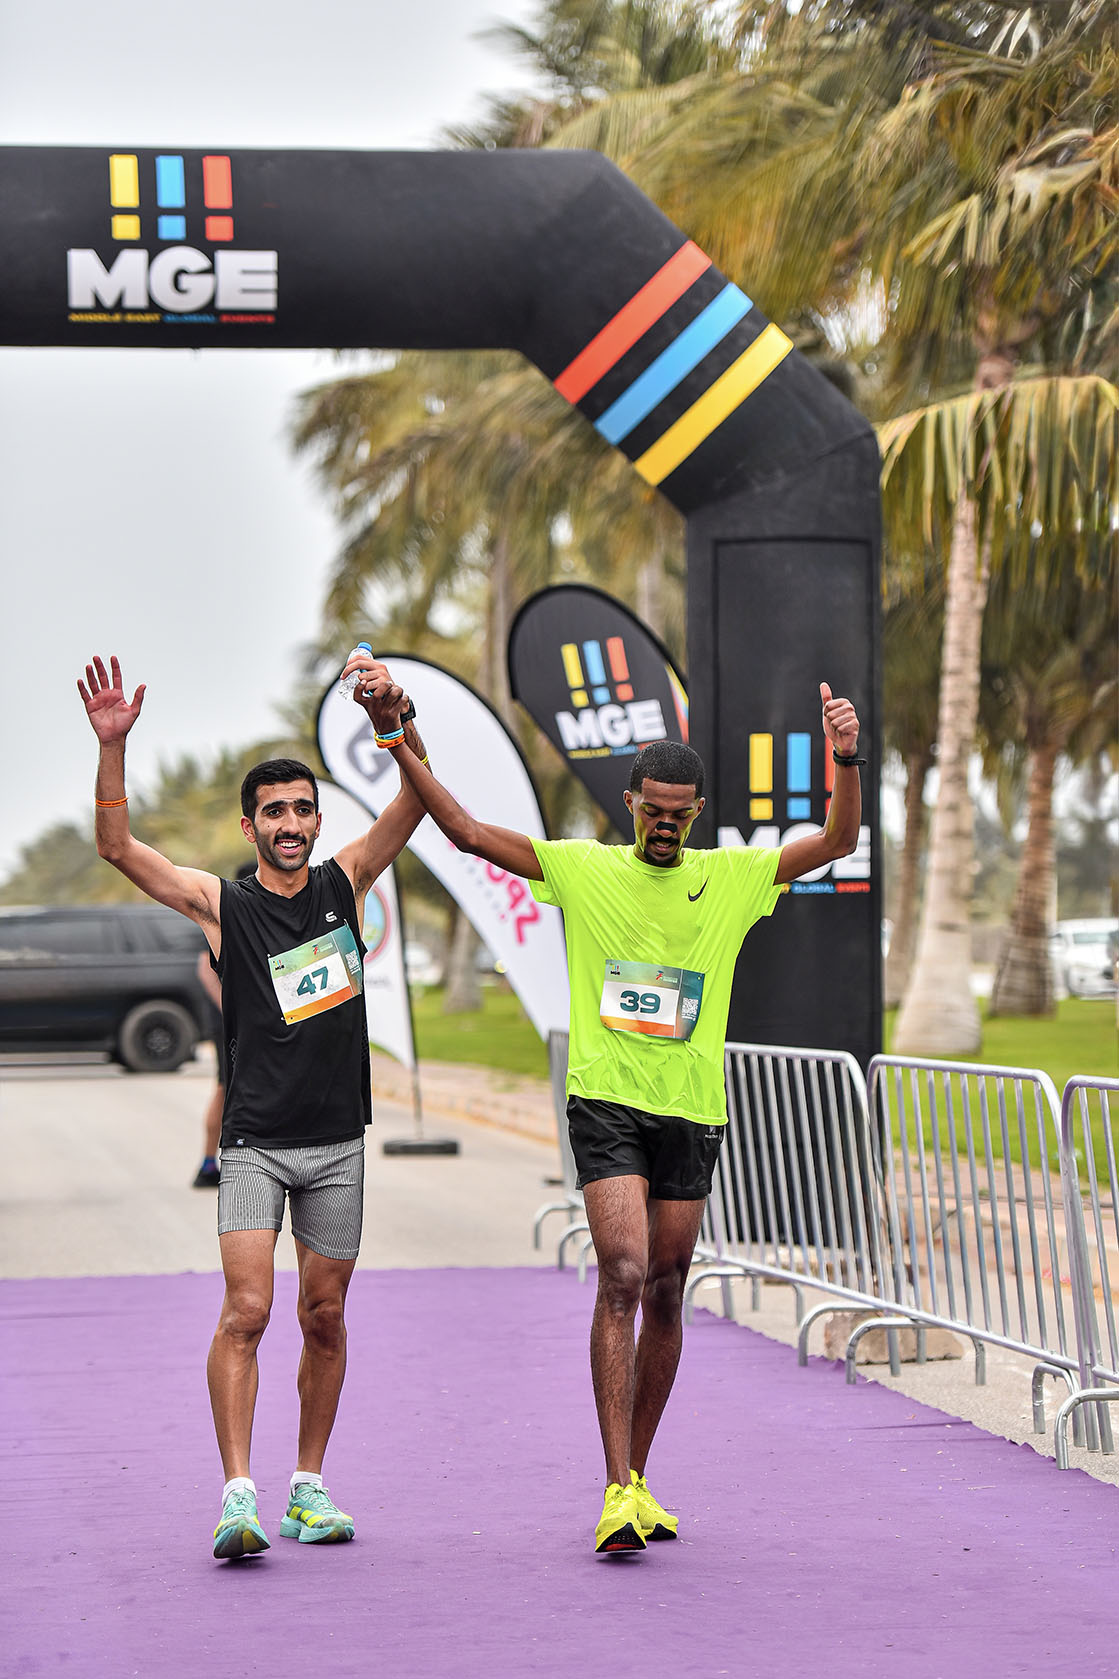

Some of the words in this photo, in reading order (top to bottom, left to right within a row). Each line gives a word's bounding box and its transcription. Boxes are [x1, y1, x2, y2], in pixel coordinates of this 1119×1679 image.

[67, 245, 278, 313] MGE
[555, 698, 668, 750] MGE
[296, 965, 329, 996] 47
[619, 990, 661, 1014] 39
